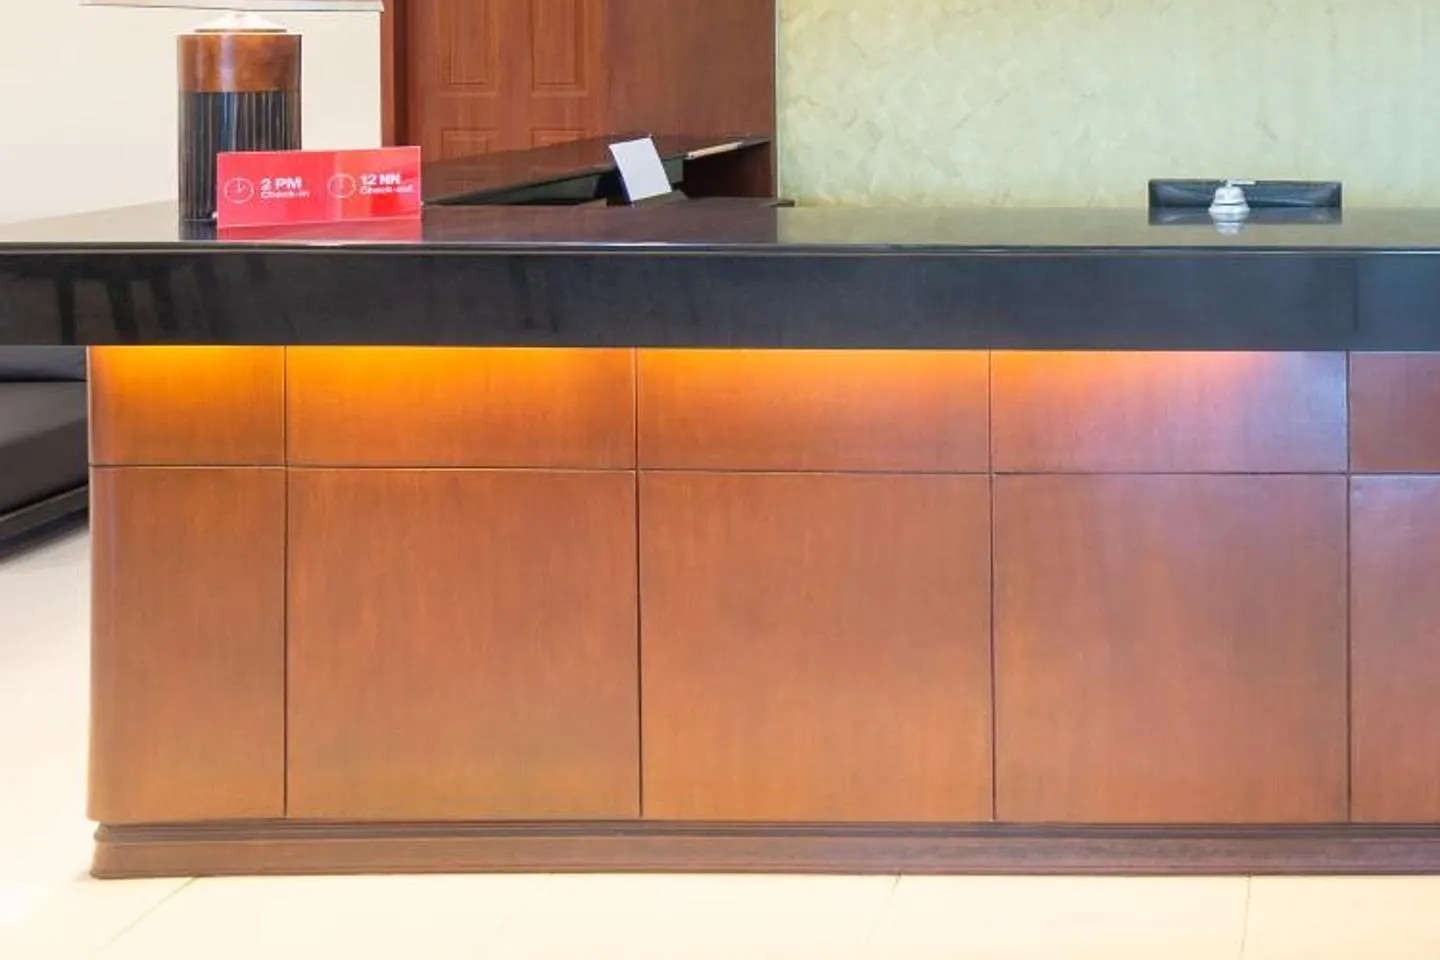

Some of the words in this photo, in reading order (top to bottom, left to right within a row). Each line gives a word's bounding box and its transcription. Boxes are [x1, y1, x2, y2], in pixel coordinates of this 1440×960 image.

[260, 178, 272, 190] 2
[275, 176, 302, 190] PM
[360, 173, 377, 186] 12
